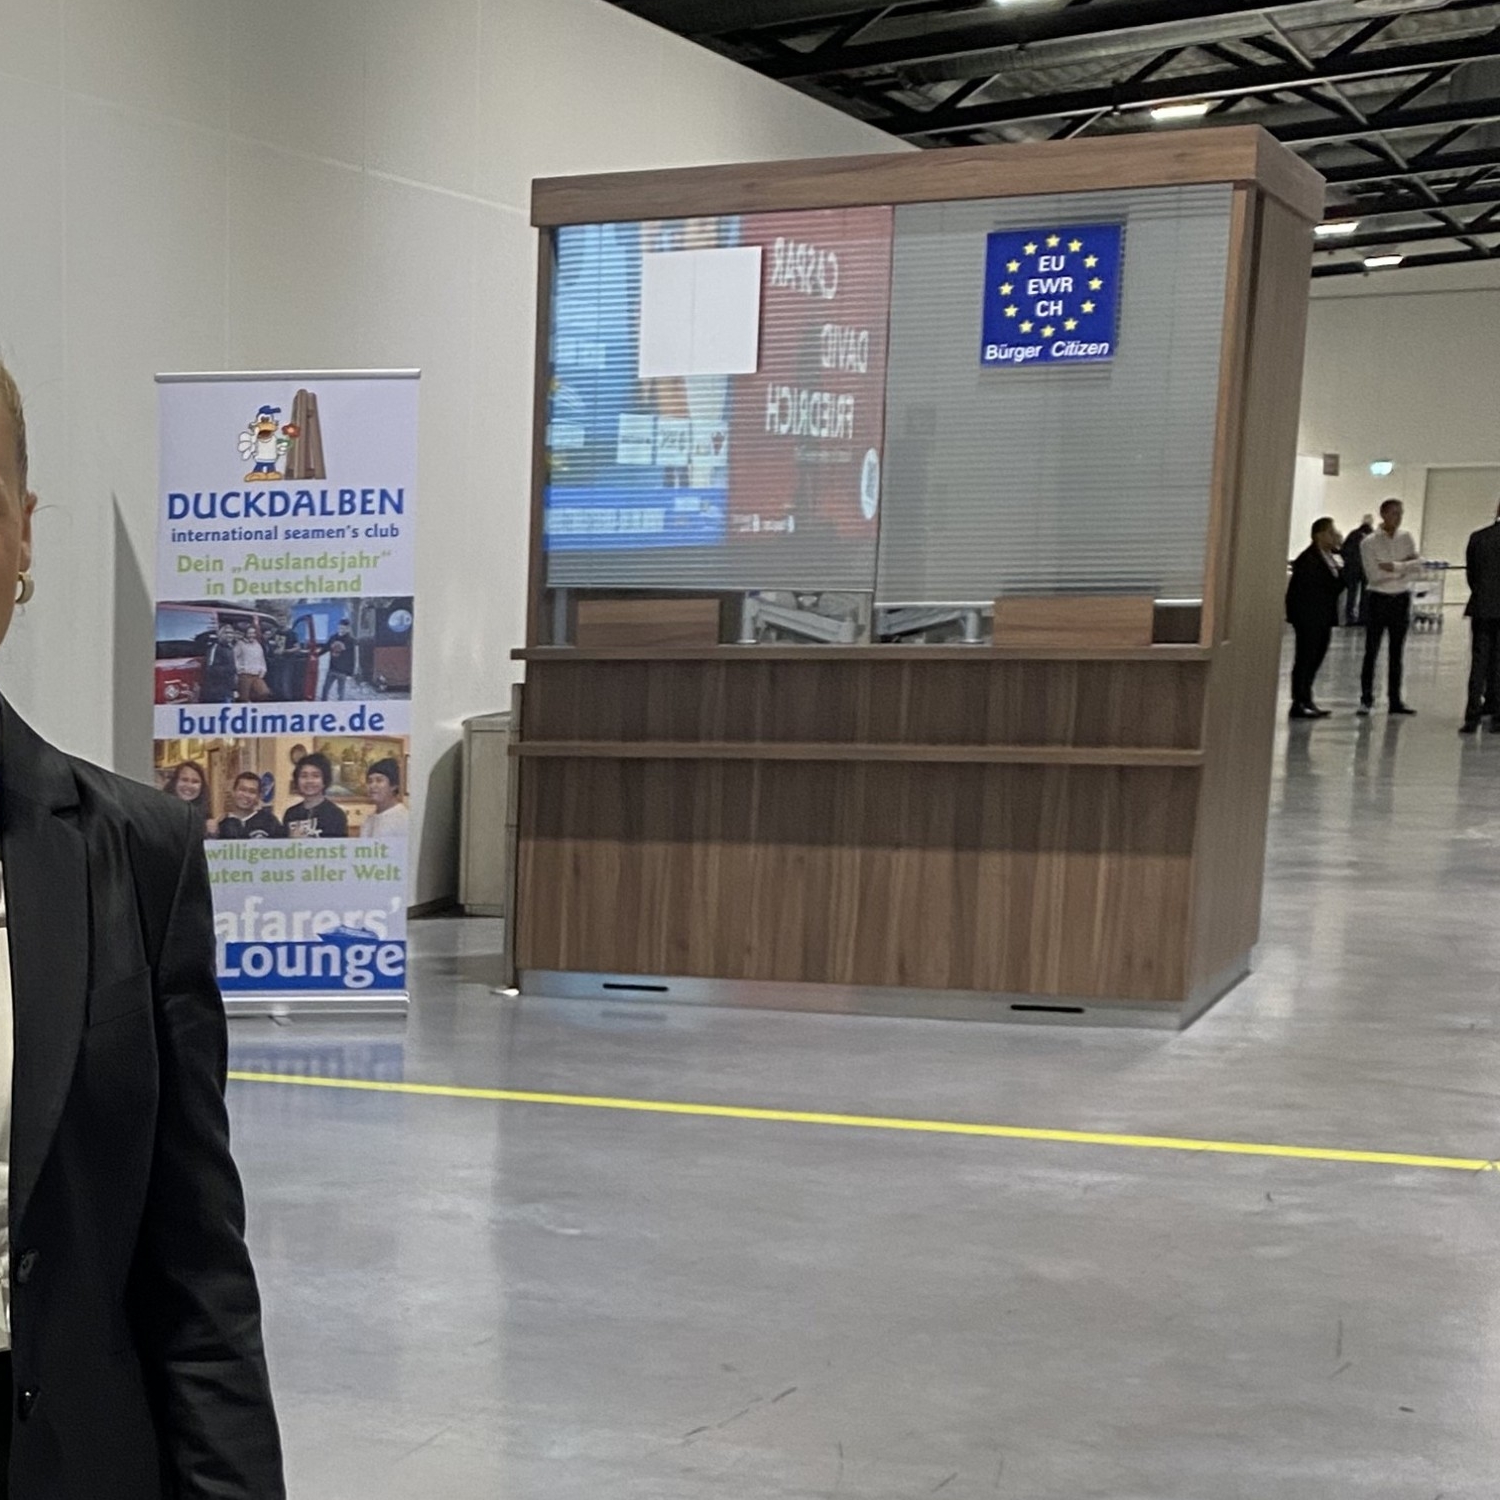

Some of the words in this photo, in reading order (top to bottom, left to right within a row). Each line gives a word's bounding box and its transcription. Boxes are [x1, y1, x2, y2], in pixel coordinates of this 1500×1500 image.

[1038, 255, 1065, 272] EU
[1027, 277, 1073, 295] EWR
[1036, 300, 1063, 317] CH
[985, 343, 1043, 362] Bürger
[1051, 340, 1110, 357] Citizen
[167, 488, 405, 520] DUCKDALBEN
[171, 526, 279, 543] international
[365, 523, 400, 538] club
[177, 554, 224, 573] Dein
[206, 577, 225, 595] in
[233, 575, 362, 596] Deutschland
[178, 704, 385, 735] bufdimare.de
[355, 841, 389, 859] mit
[260, 868, 295, 882] aus
[301, 865, 346, 882] aller
[353, 864, 401, 882] Welt
[216, 940, 406, 989] Lounge
